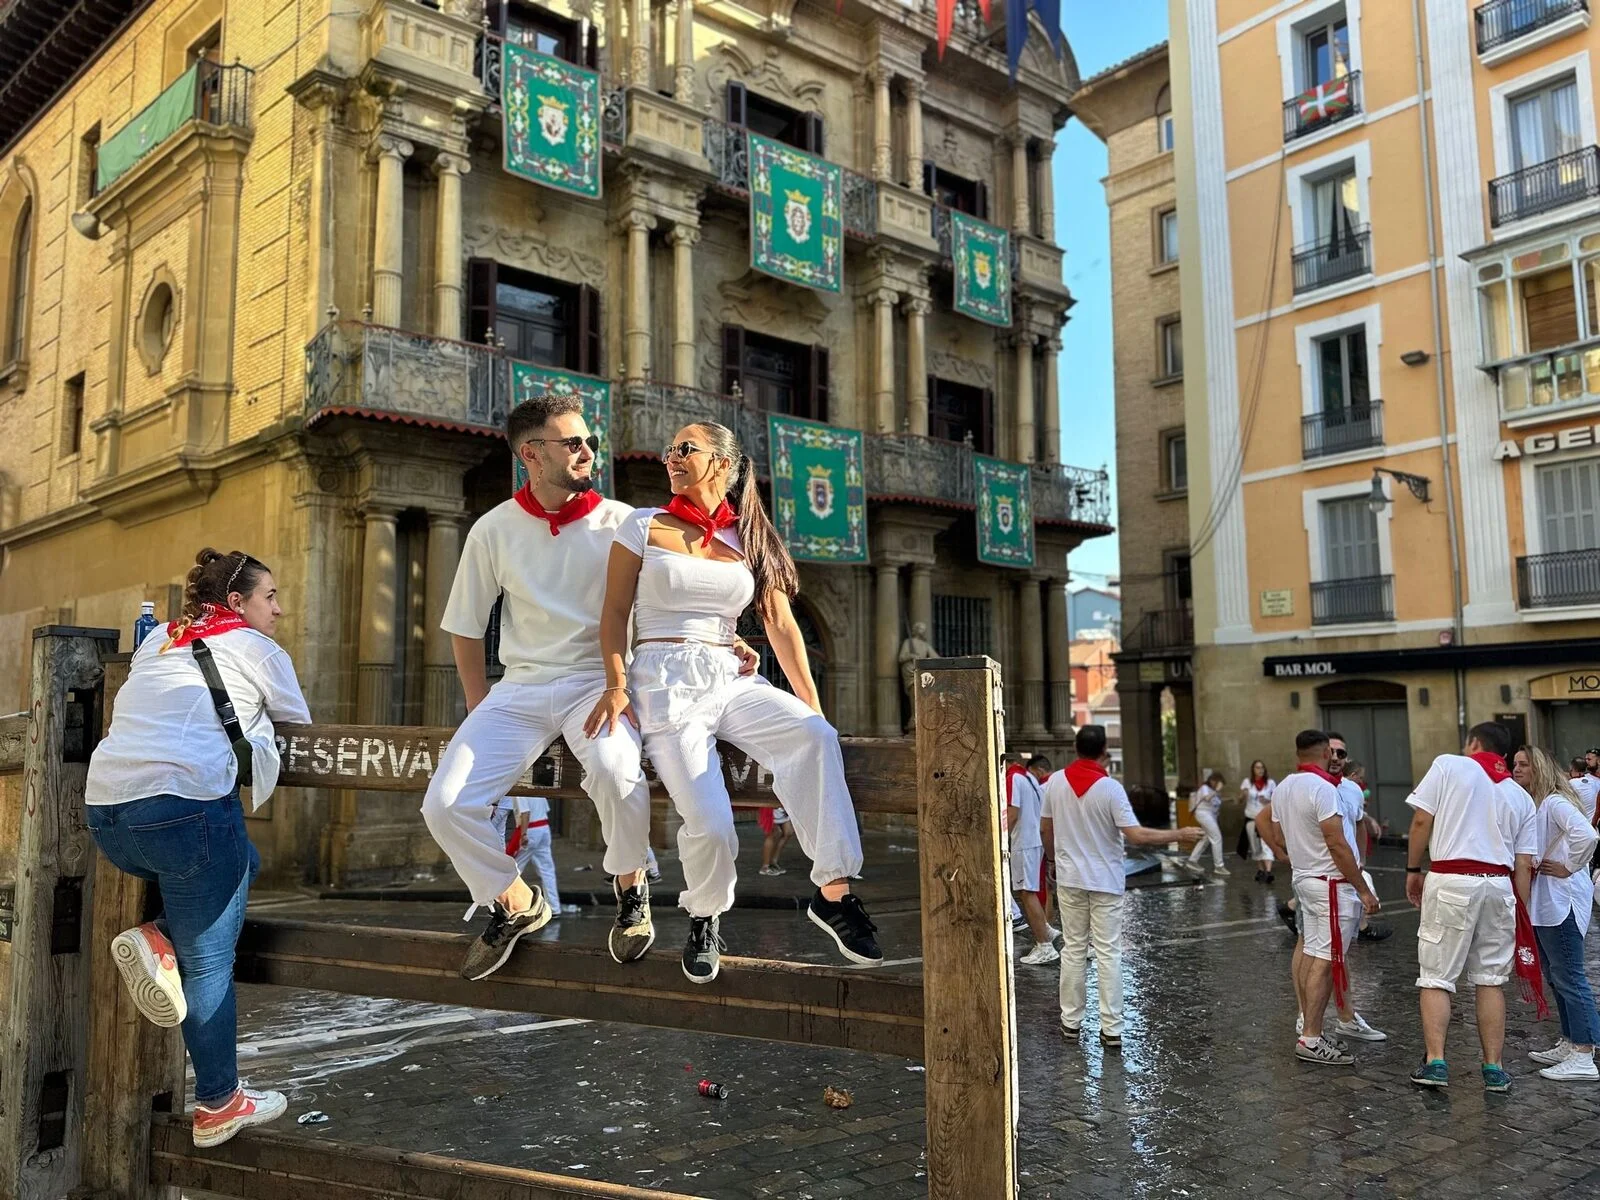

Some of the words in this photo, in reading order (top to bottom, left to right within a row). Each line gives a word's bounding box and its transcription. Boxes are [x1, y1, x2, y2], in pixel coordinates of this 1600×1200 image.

[1493, 425, 1600, 461] AGE
[1275, 663, 1303, 676] BAR
[1304, 661, 1337, 675] MOL
